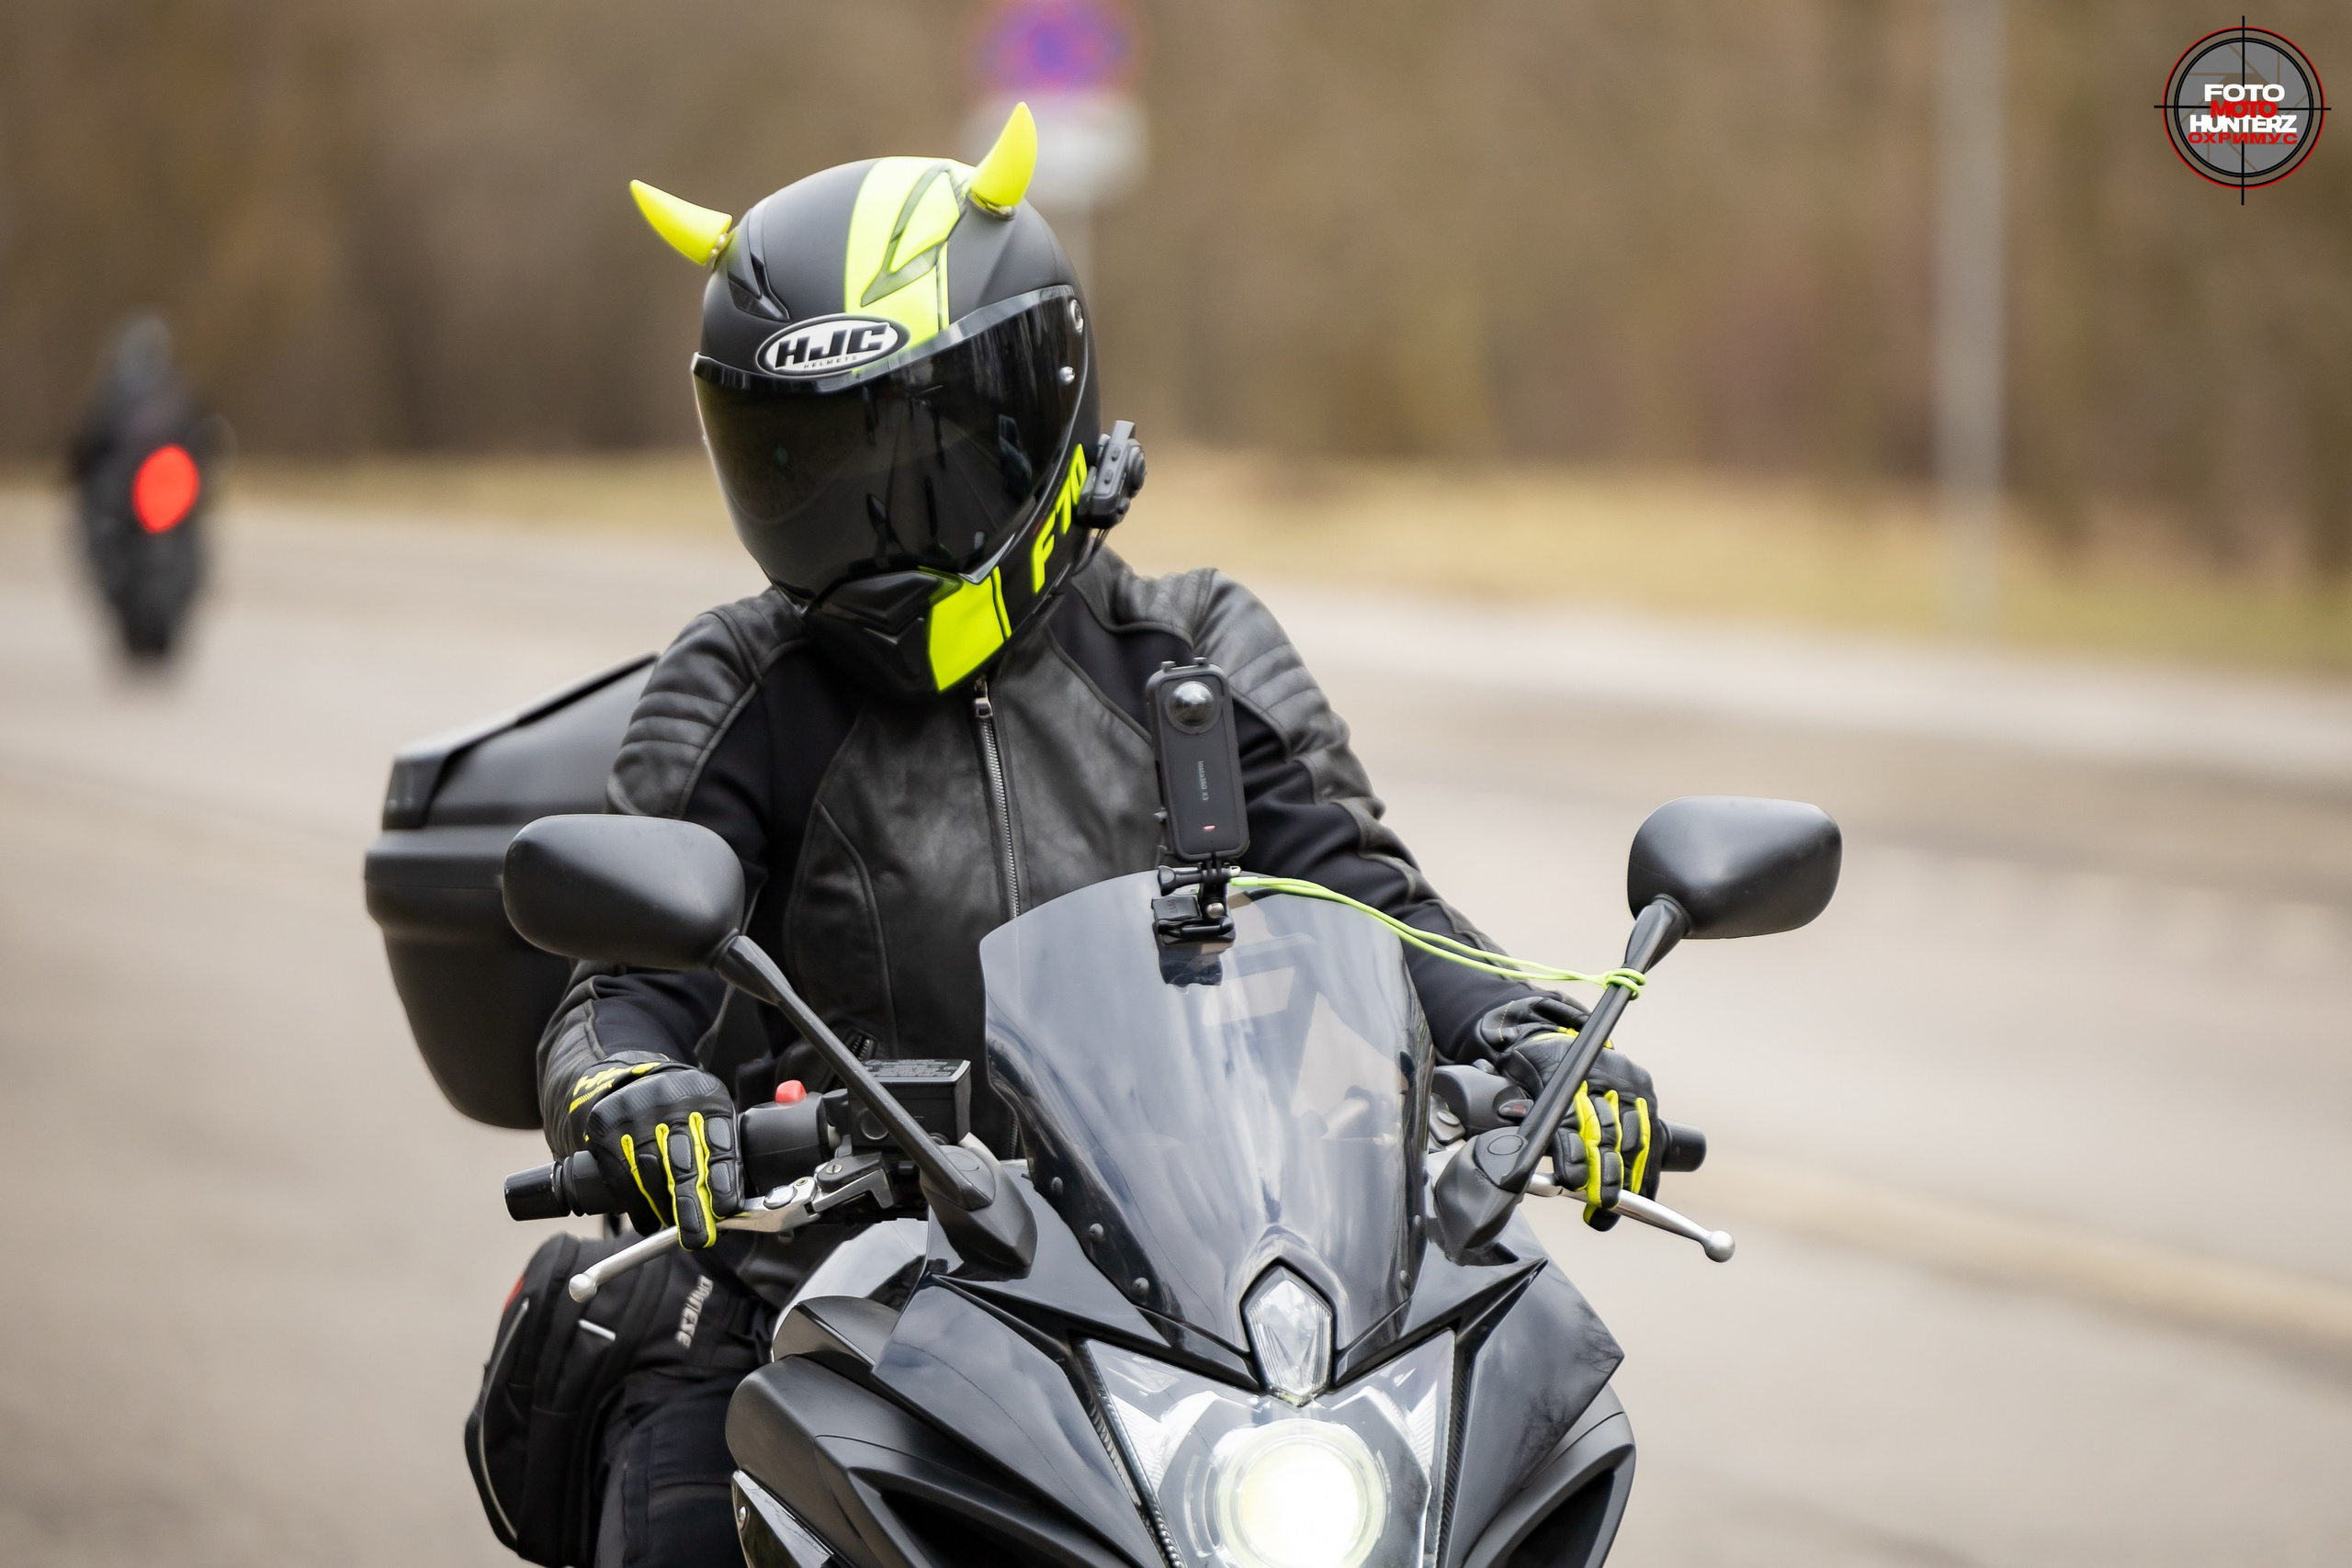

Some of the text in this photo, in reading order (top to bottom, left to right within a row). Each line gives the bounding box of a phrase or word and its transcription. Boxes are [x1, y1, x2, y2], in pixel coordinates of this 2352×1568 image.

[775, 322, 890, 369] HJC
[803, 355, 857, 369] HELMETS
[1197, 761, 1207, 790] Insta360
